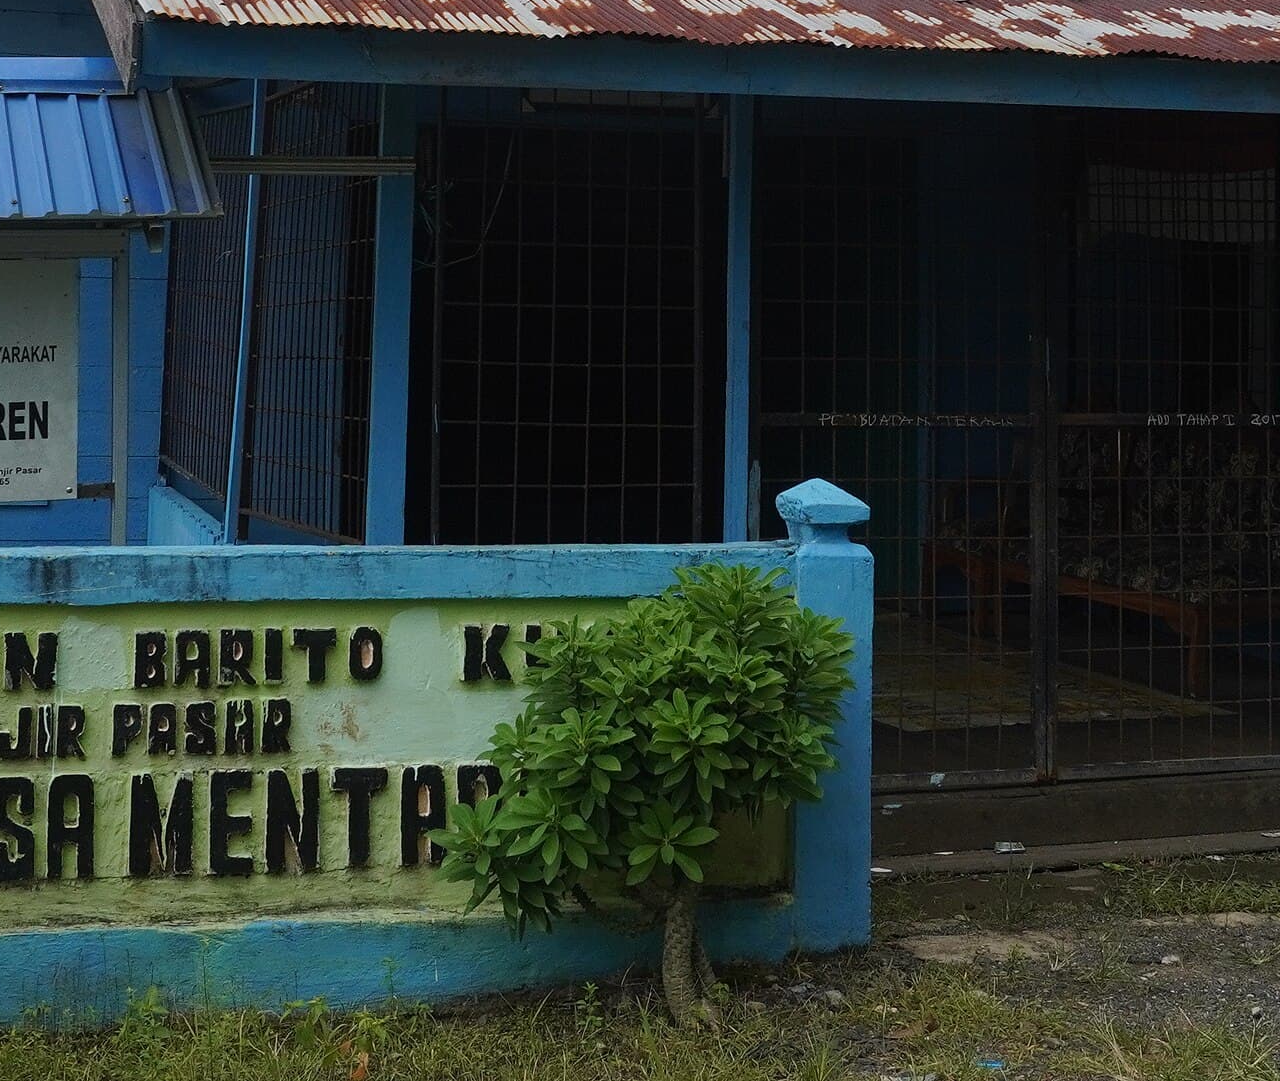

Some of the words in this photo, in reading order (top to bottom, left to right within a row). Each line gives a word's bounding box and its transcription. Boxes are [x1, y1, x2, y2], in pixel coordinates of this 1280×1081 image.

[16, 466, 42, 474] Pasar
[134, 625, 384, 689] BARITO
[111, 697, 293, 759] PASAR
